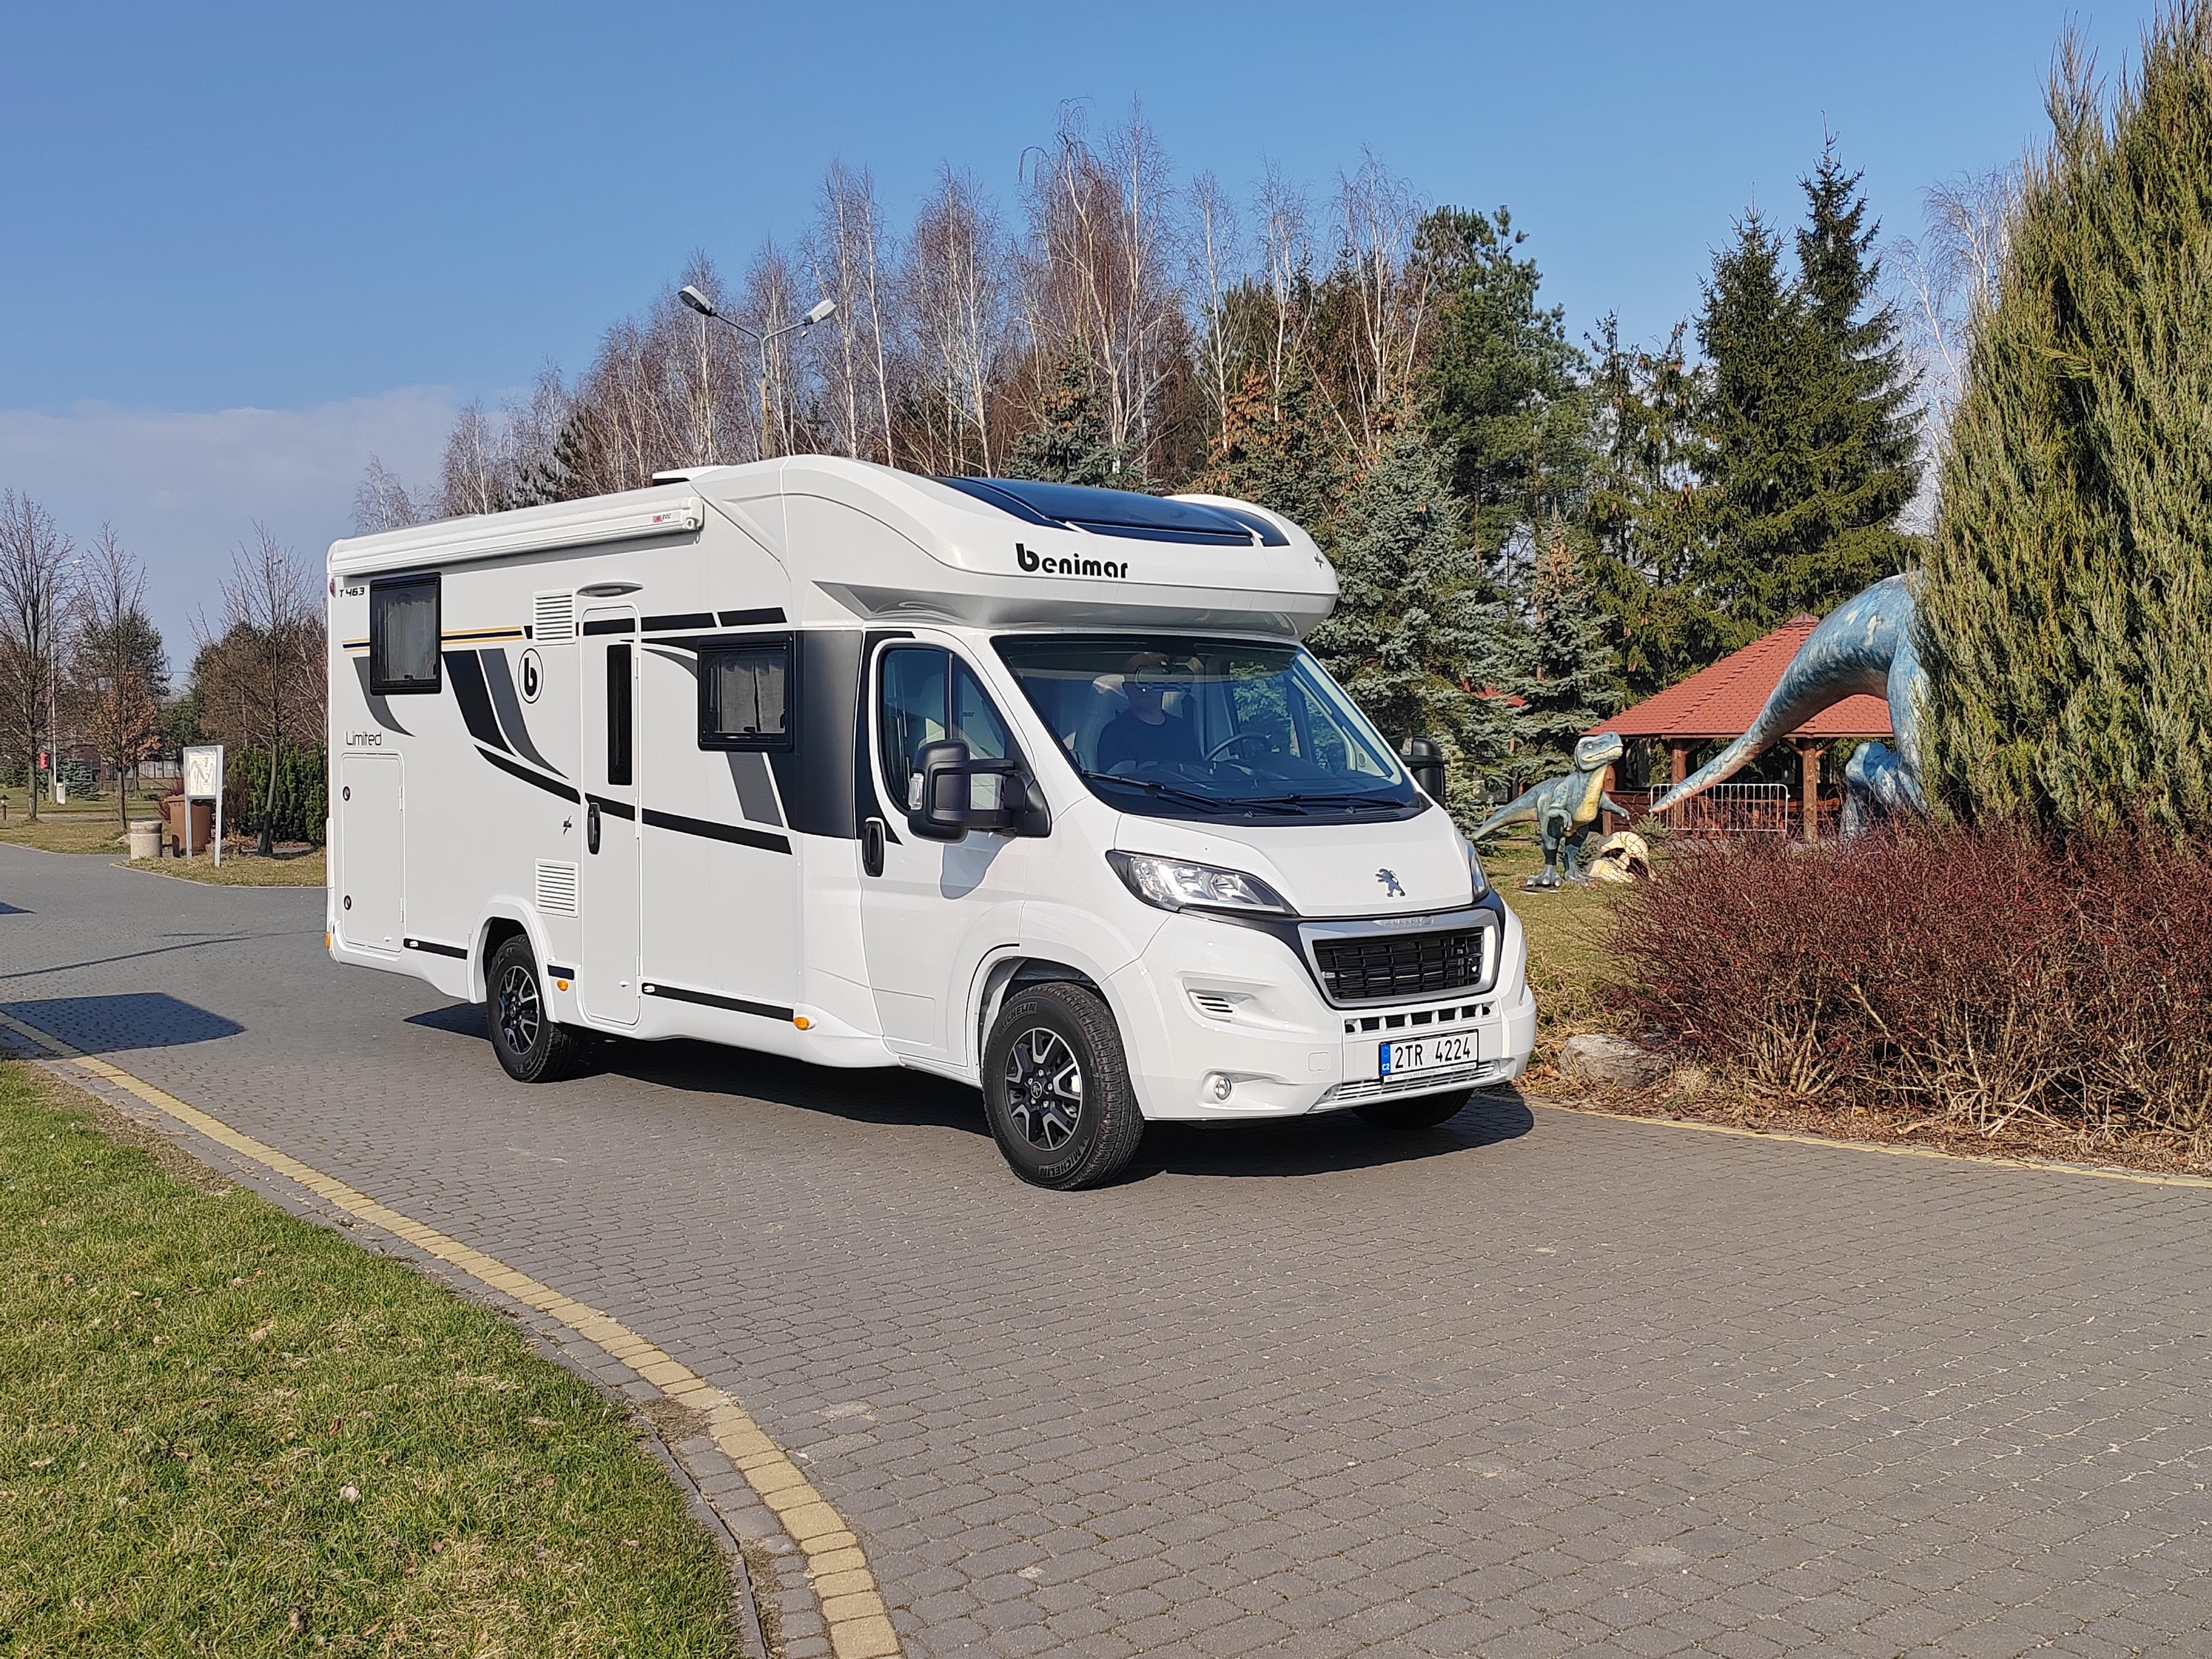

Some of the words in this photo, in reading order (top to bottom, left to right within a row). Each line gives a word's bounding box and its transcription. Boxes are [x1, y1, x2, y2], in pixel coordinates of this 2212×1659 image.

[1015, 543, 1128, 578] benimar
[339, 589, 345, 598] T
[346, 587, 365, 597] 463
[346, 731, 382, 745] Limited
[1395, 1044, 1423, 1069] 2TR
[1435, 1037, 1470, 1062] 4224
[1382, 1063, 1390, 1071] CZ
